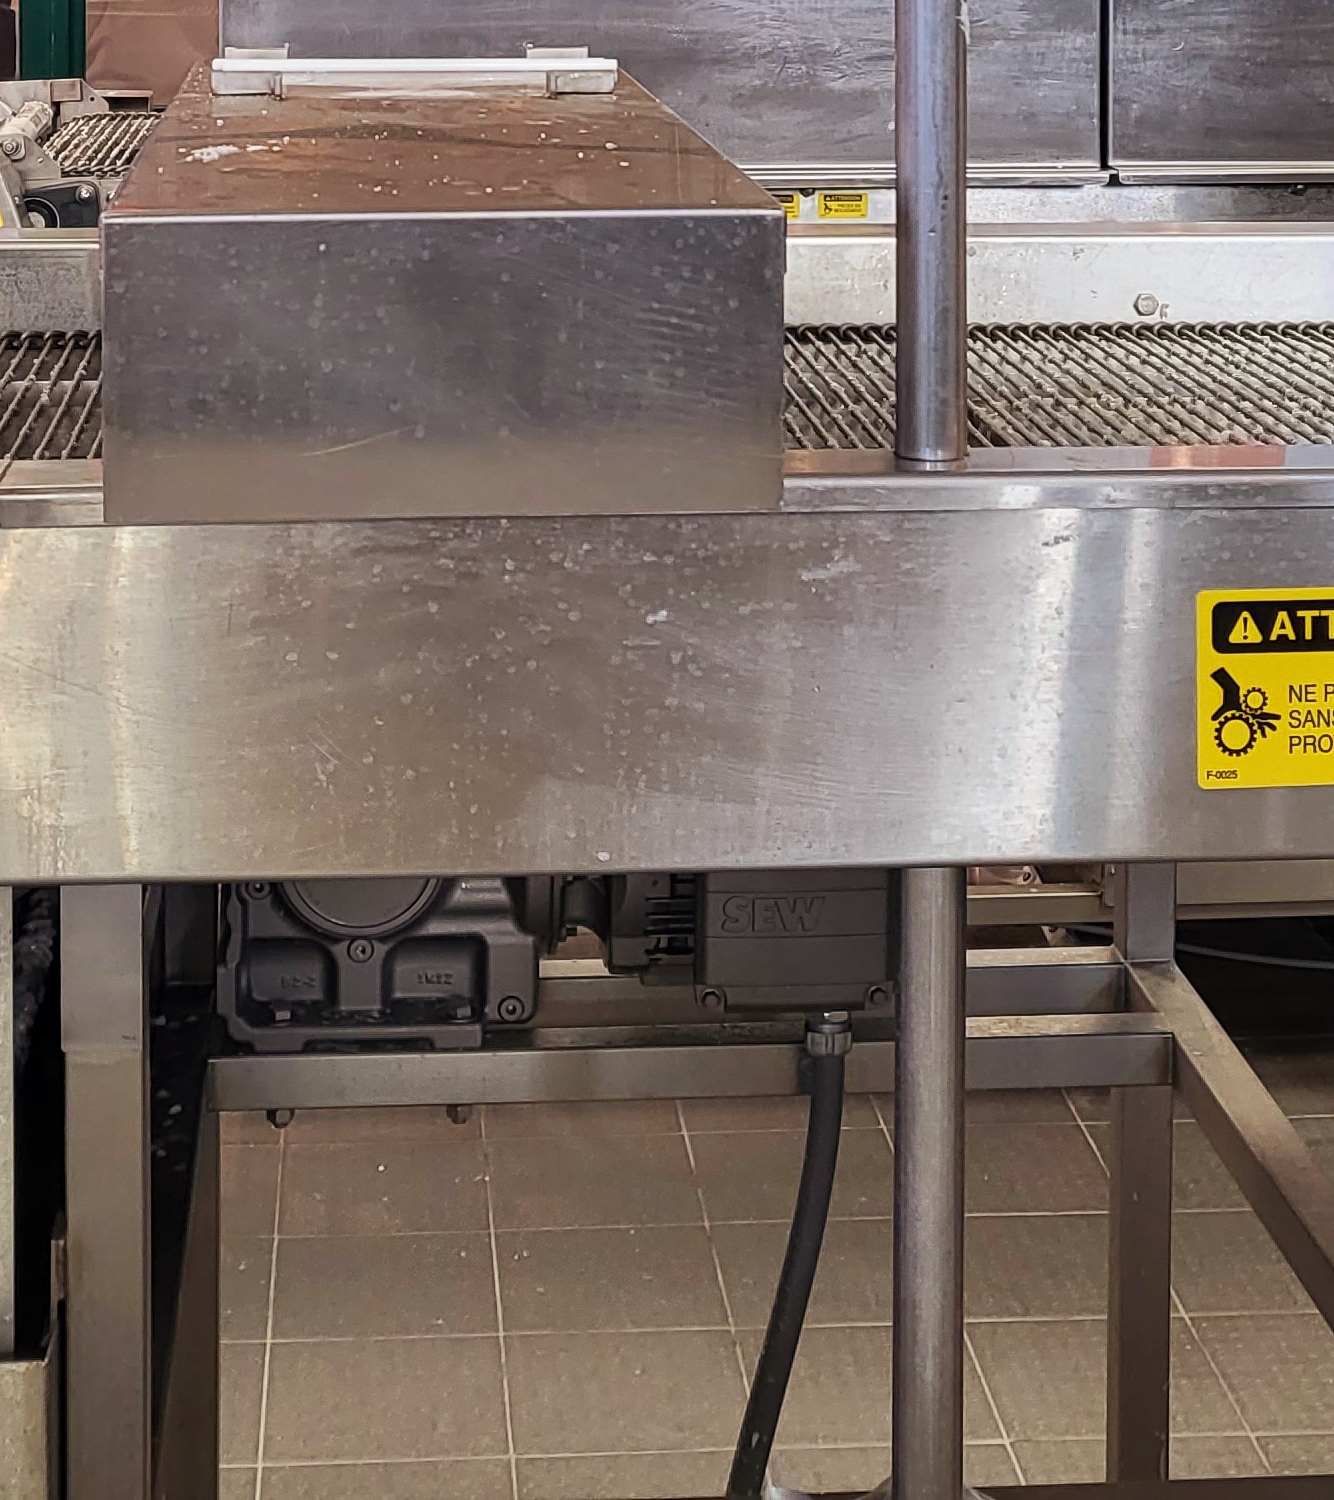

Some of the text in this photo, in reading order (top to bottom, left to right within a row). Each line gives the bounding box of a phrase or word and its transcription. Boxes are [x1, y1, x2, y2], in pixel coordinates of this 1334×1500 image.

[1288, 684, 1317, 703] NE
[1206, 770, 1238, 780] F-0025
[721, 895, 826, 934] SEW
